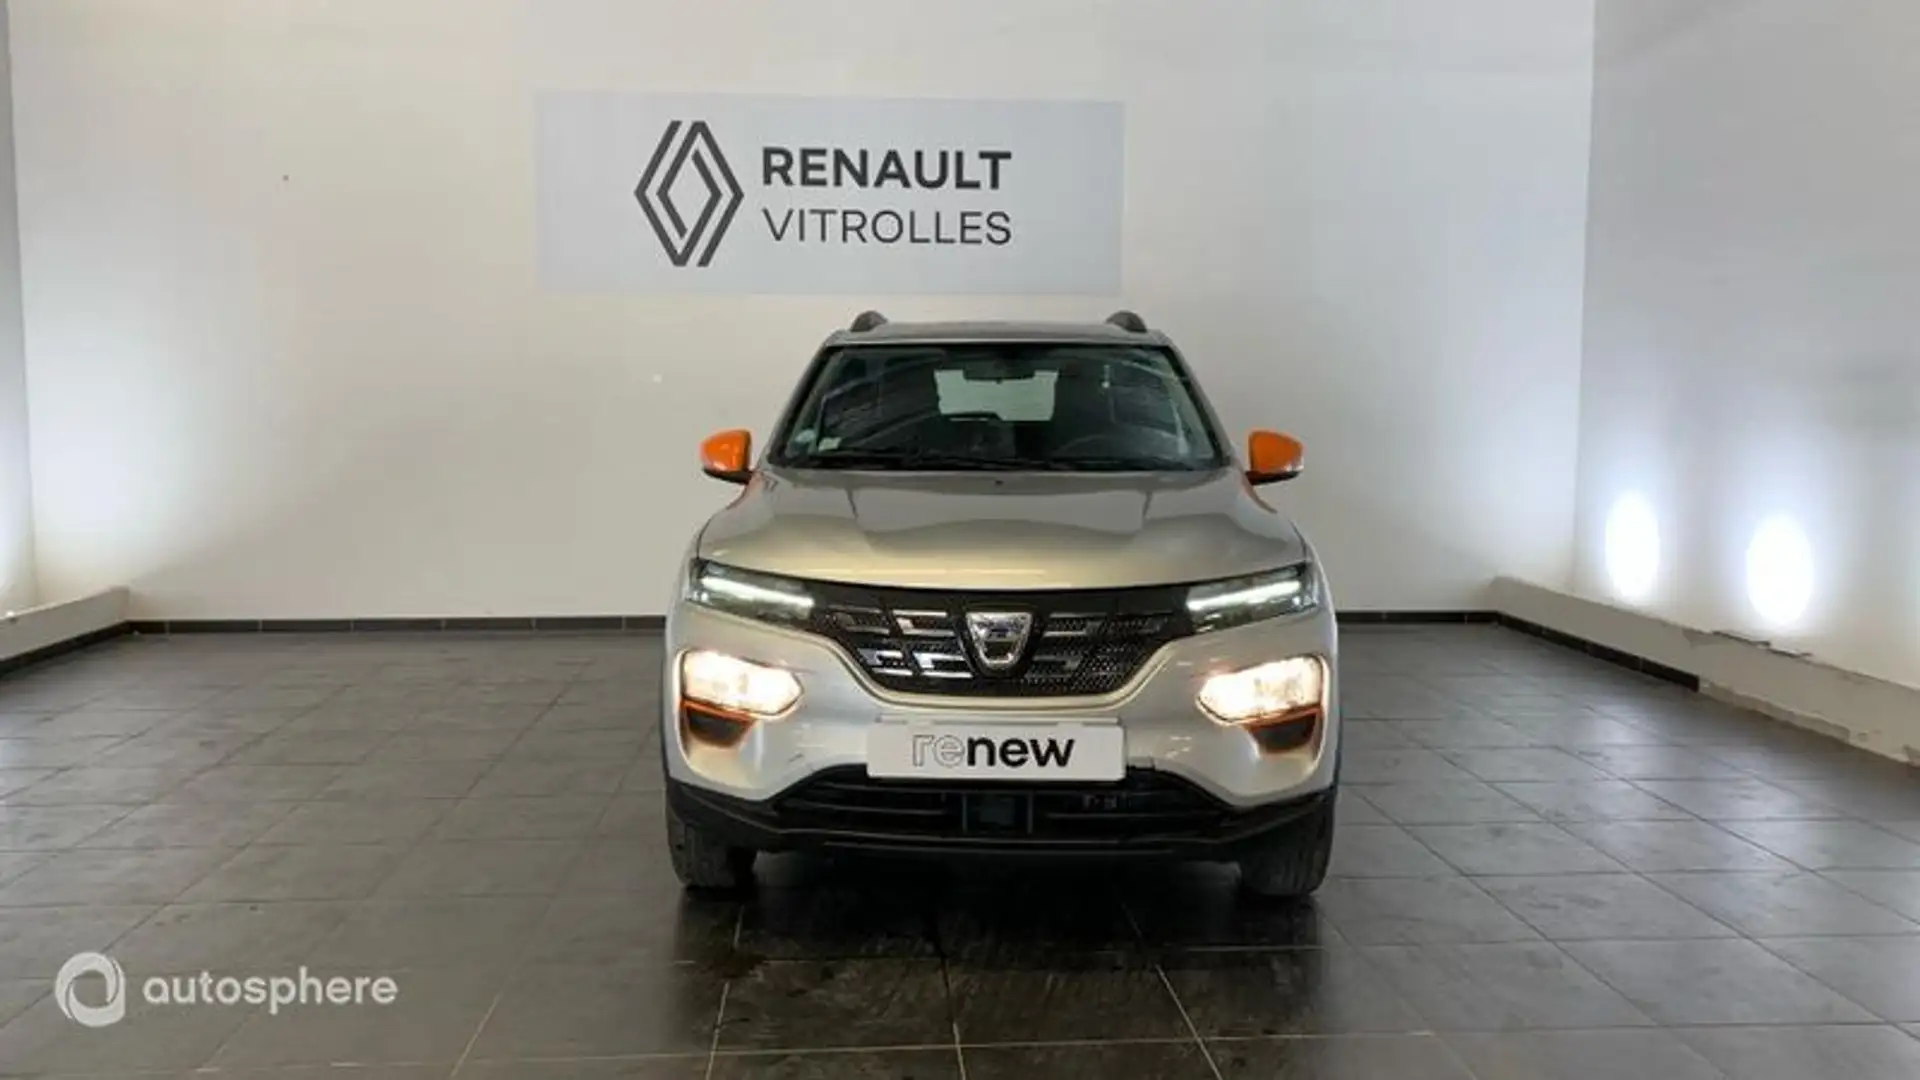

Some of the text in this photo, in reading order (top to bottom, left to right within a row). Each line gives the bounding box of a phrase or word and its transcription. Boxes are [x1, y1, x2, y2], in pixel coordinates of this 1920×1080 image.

[762, 147, 1012, 190] RENAULT
[762, 208, 1013, 246] VITROLLES
[912, 734, 1076, 769] renew
